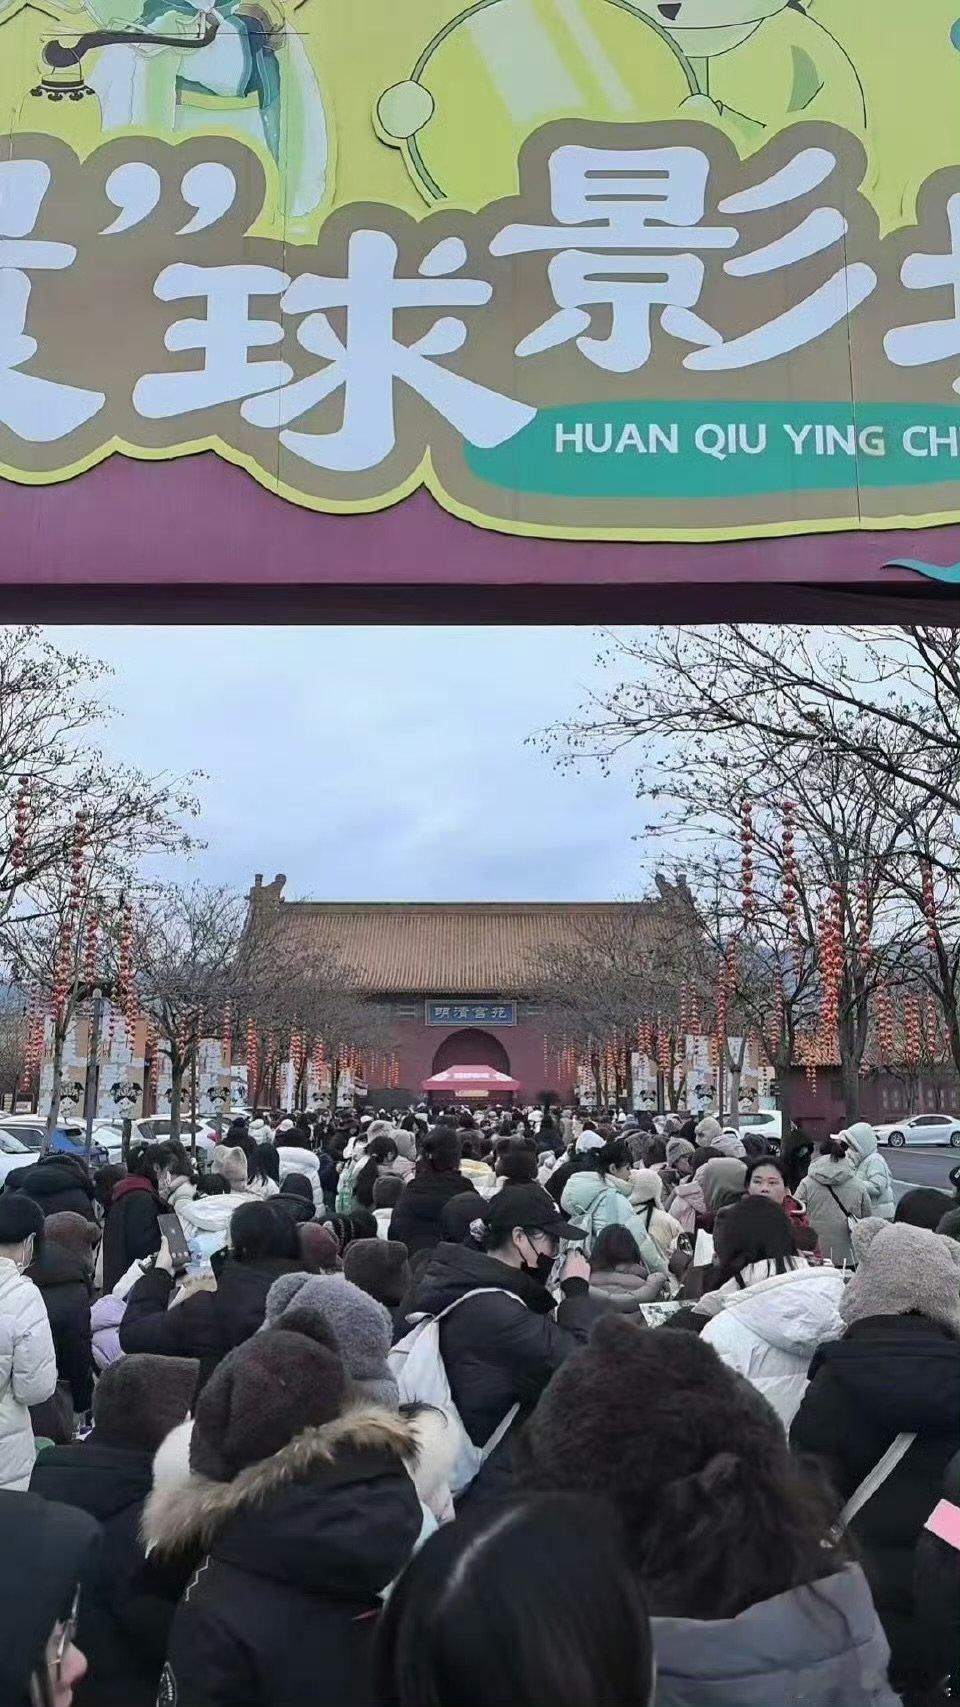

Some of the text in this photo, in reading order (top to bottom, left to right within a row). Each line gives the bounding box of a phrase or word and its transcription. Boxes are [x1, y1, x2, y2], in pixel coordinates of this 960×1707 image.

[0, 145, 960, 472] ”球影
[555, 423, 960, 461] HUAN QIU YING CH
